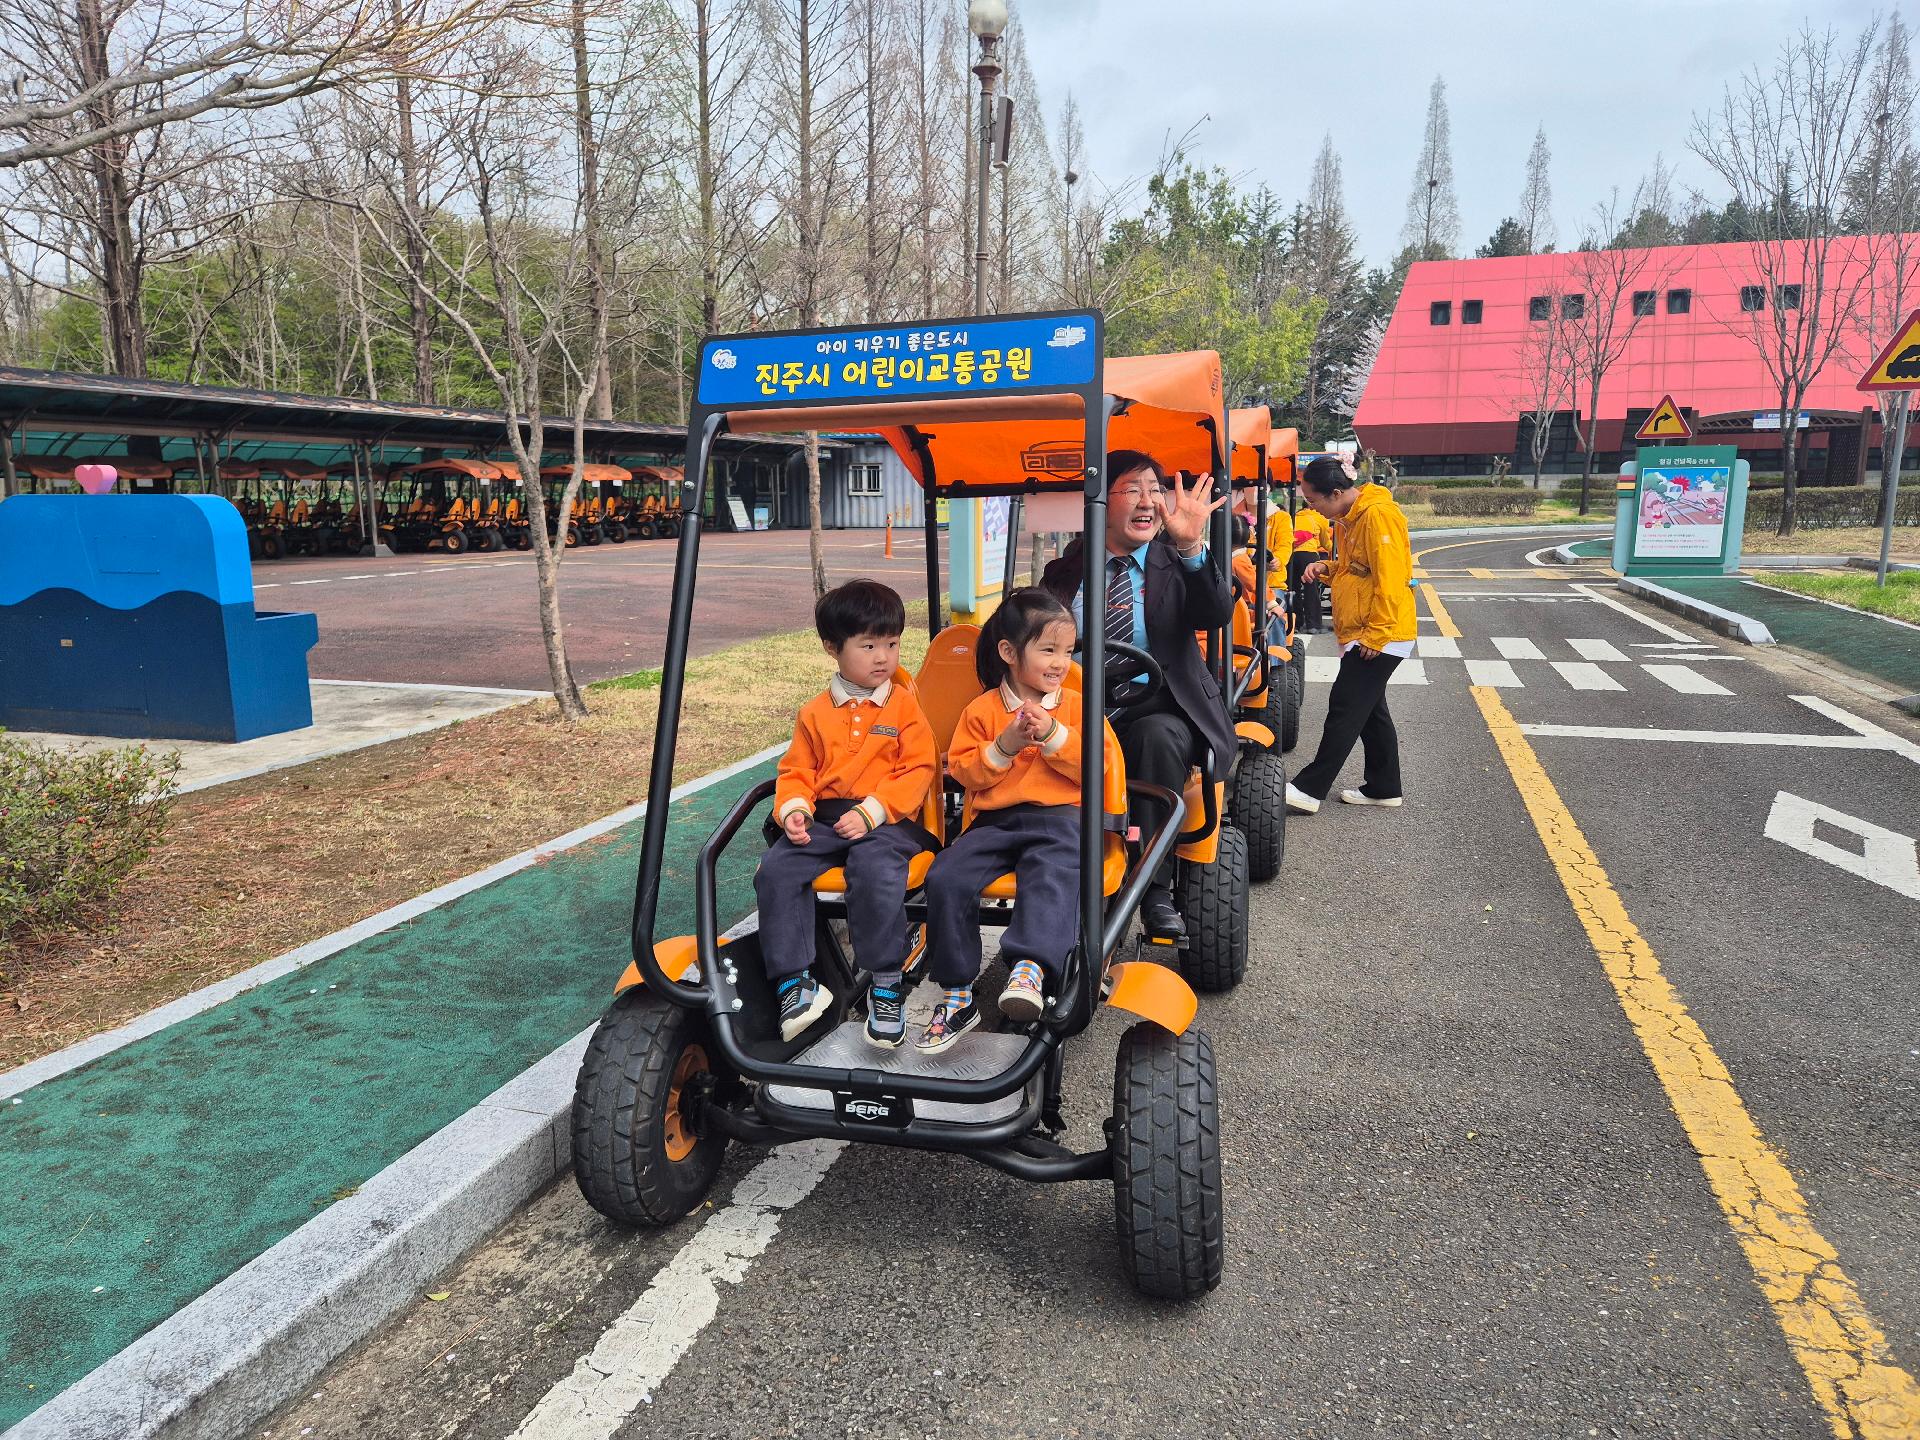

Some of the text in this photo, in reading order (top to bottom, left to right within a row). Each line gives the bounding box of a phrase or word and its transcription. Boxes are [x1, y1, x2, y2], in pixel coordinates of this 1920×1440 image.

[816, 331, 968, 355] 아이 키우기 좋은도시
[755, 347, 1032, 395] 진주시 어린이교통공원
[845, 1104, 889, 1116] BERG
